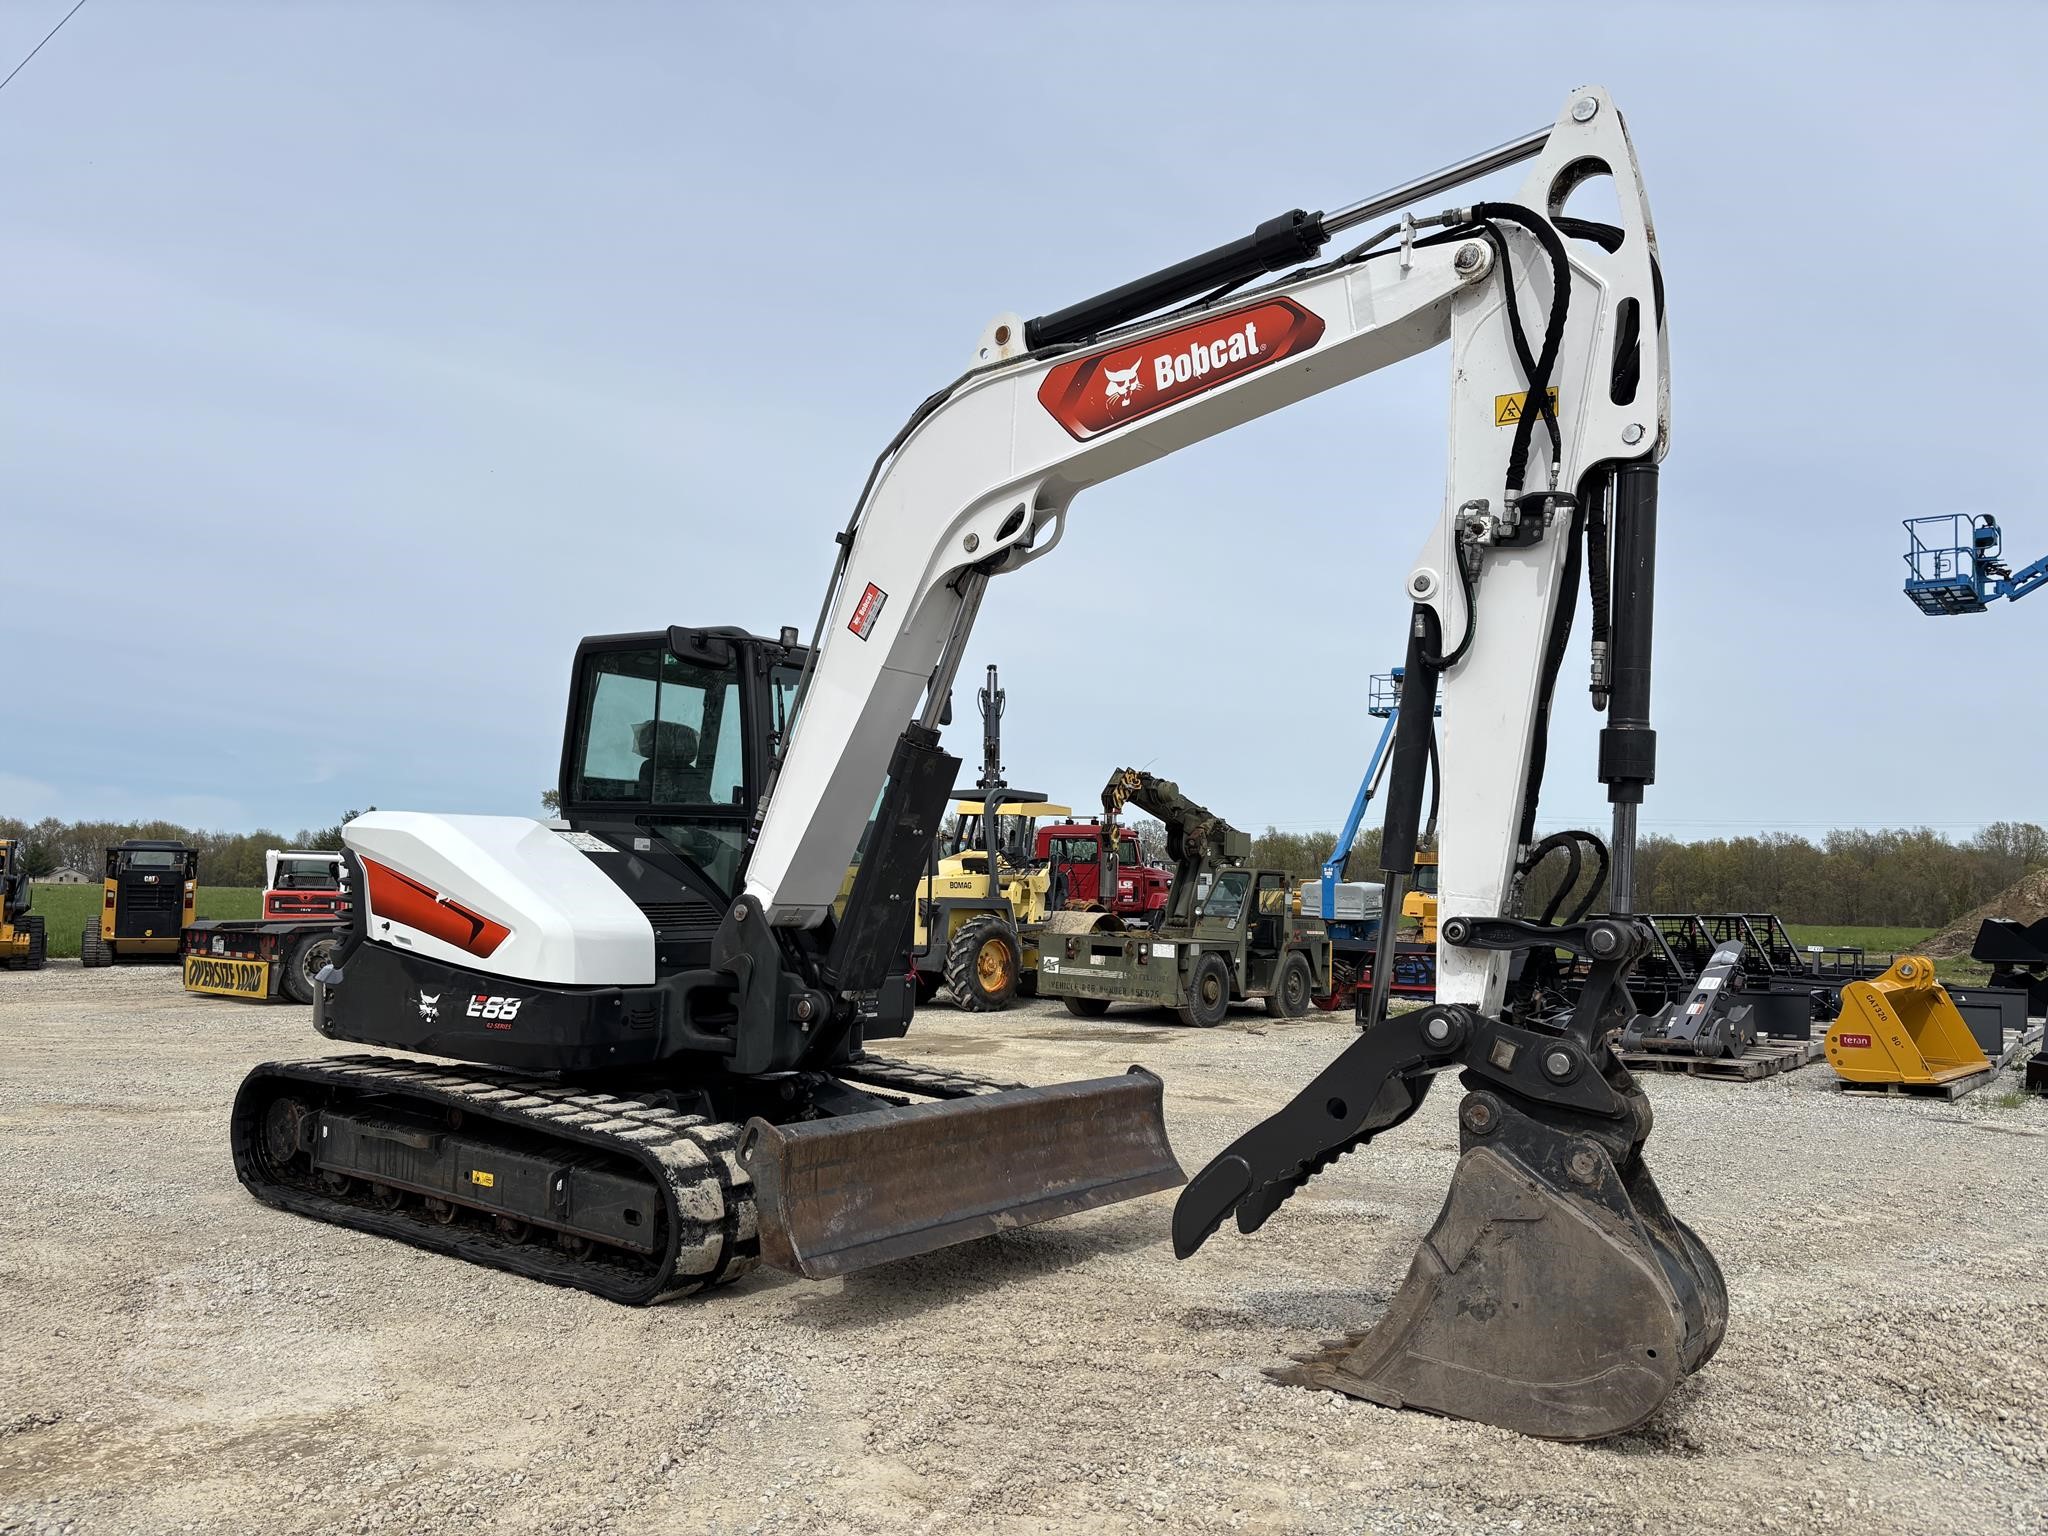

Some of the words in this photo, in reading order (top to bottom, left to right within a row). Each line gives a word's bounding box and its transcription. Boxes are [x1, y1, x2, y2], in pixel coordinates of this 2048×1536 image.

[1154, 322, 1259, 391] Bobcat
[189, 960, 235, 989] OVERSIZE
[236, 964, 262, 992] LOAD
[466, 995, 522, 1020] E88
[1844, 1037, 1868, 1045] teran
